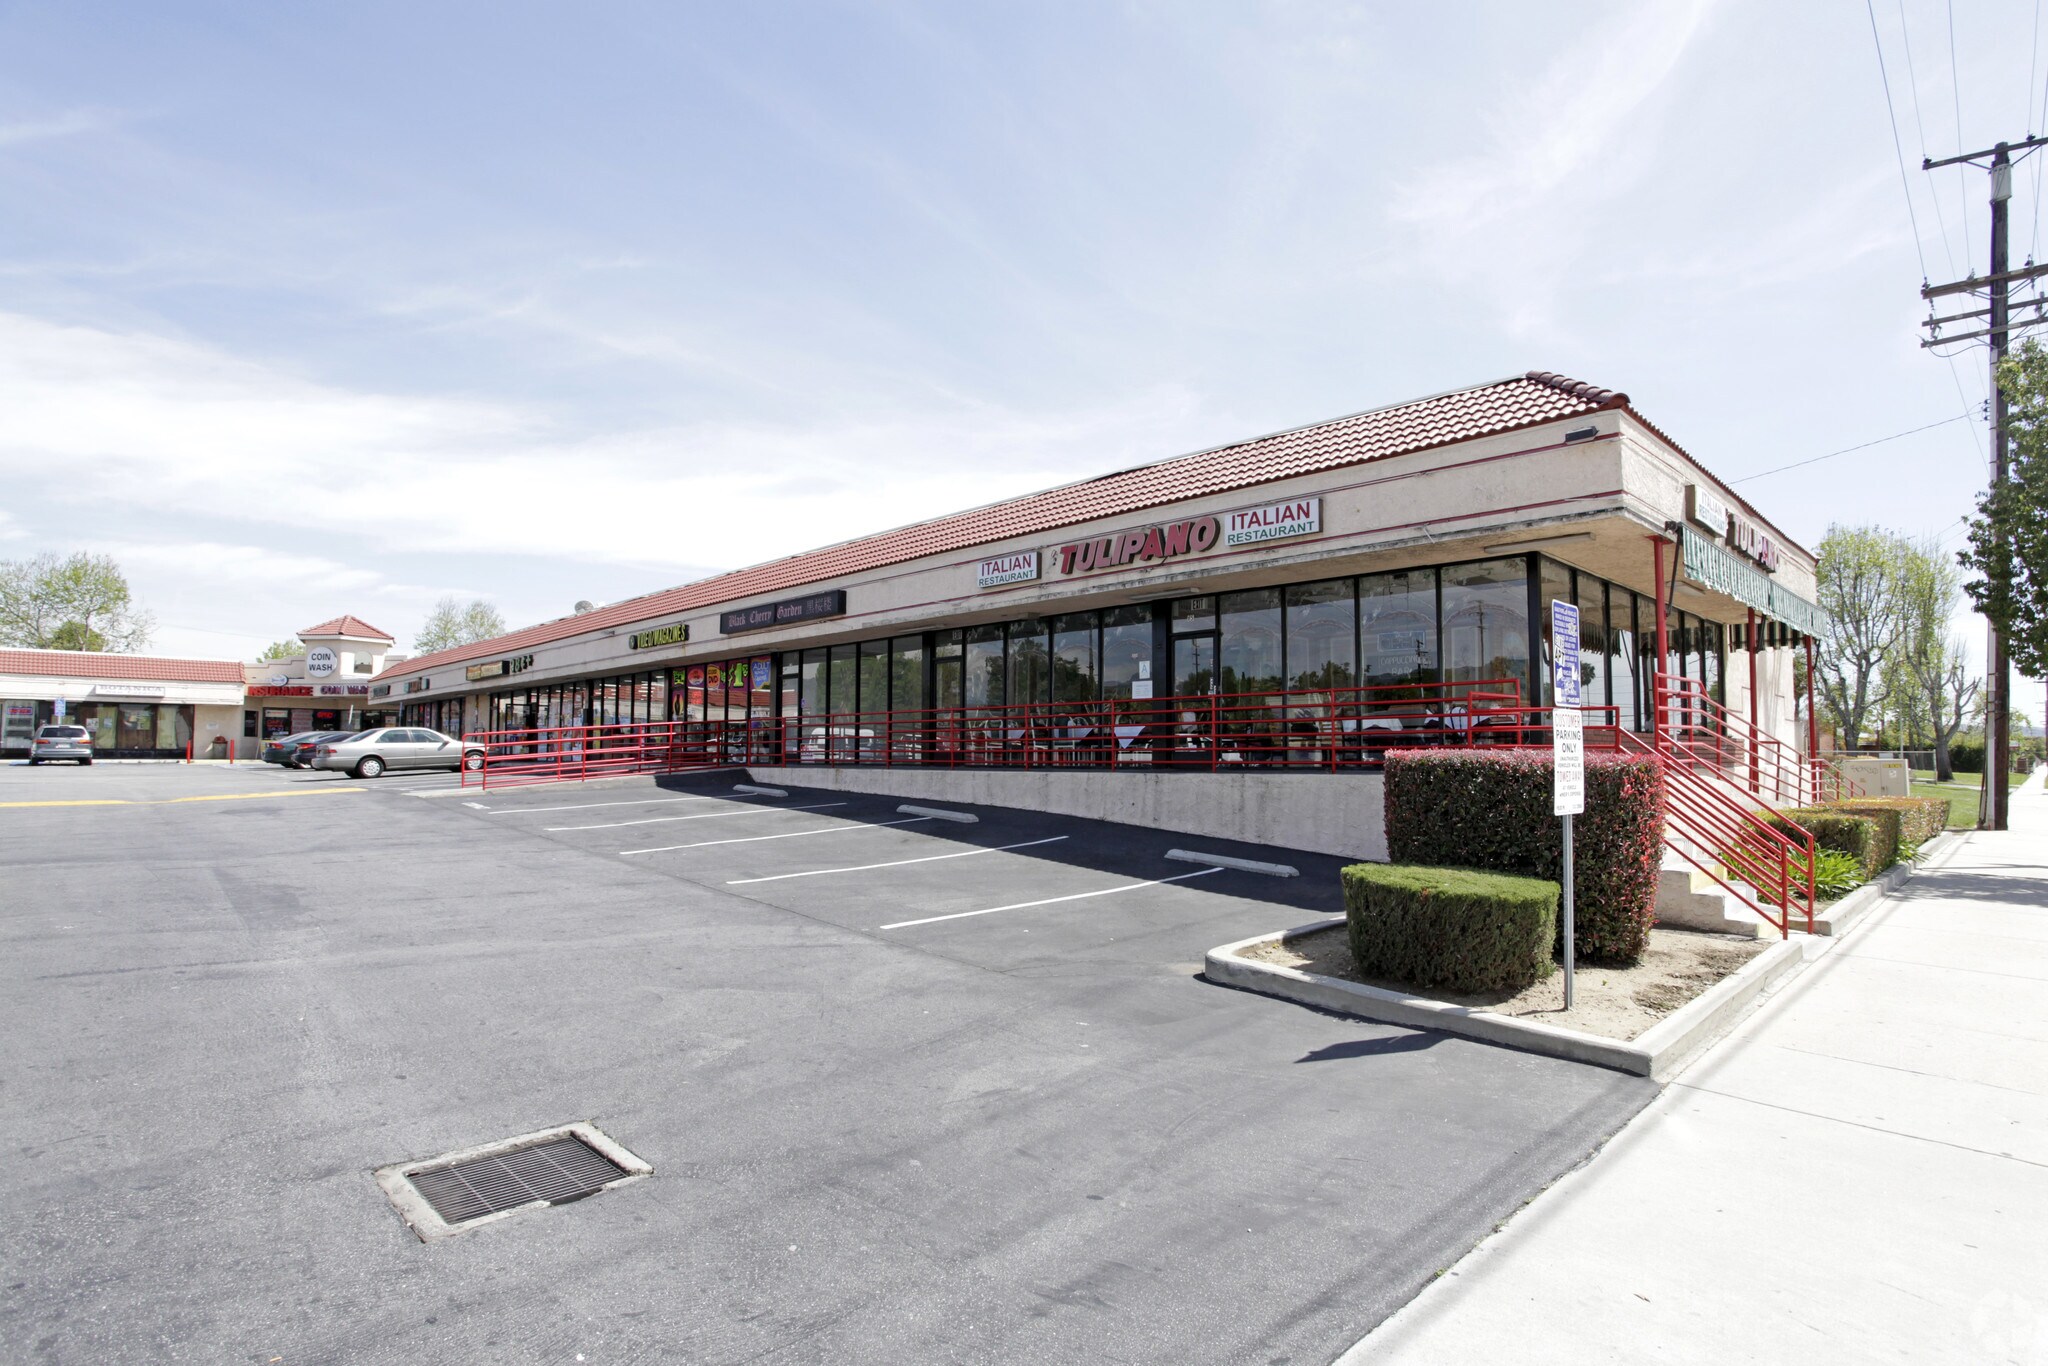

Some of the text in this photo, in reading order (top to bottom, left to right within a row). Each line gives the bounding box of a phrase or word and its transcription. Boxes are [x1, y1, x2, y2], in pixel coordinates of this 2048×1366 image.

[1231, 502, 1310, 531] ITALIAN
[1227, 521, 1315, 544] RESTAURANT
[1060, 516, 1217, 574] TULIPANO
[981, 554, 1032, 577] ITALIAN
[978, 570, 1034, 586] RESTAURANT
[728, 604, 802, 628] Black Cherry Garden
[311, 653, 331, 661] COIN
[308, 664, 333, 672] WASH
[248, 686, 313, 696] INSURANCE
[1555, 713, 1580, 728] CUSTOMER
[1556, 729, 1581, 741] PARKING
[1562, 742, 1577, 753] ONLY
